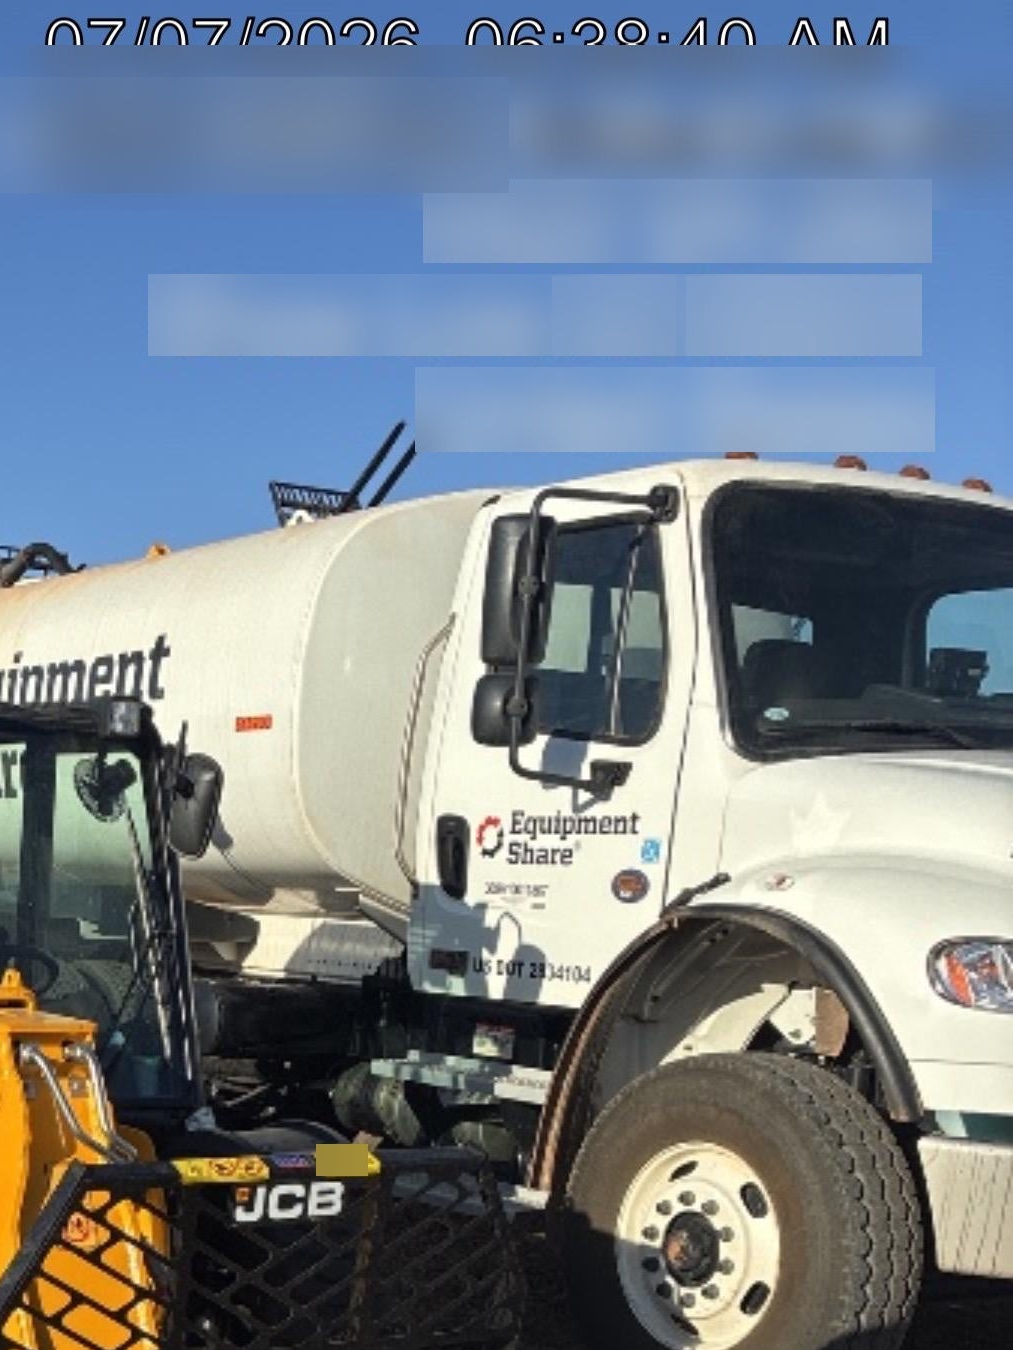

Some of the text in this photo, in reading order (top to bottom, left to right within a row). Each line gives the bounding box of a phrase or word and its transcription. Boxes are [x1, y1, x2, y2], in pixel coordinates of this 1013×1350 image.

[509, 809, 642, 841] Equipment
[506, 841, 574, 866] Share
[473, 956, 492, 974] US
[496, 959, 525, 979] DOT
[234, 1181, 345, 1222] JCB
